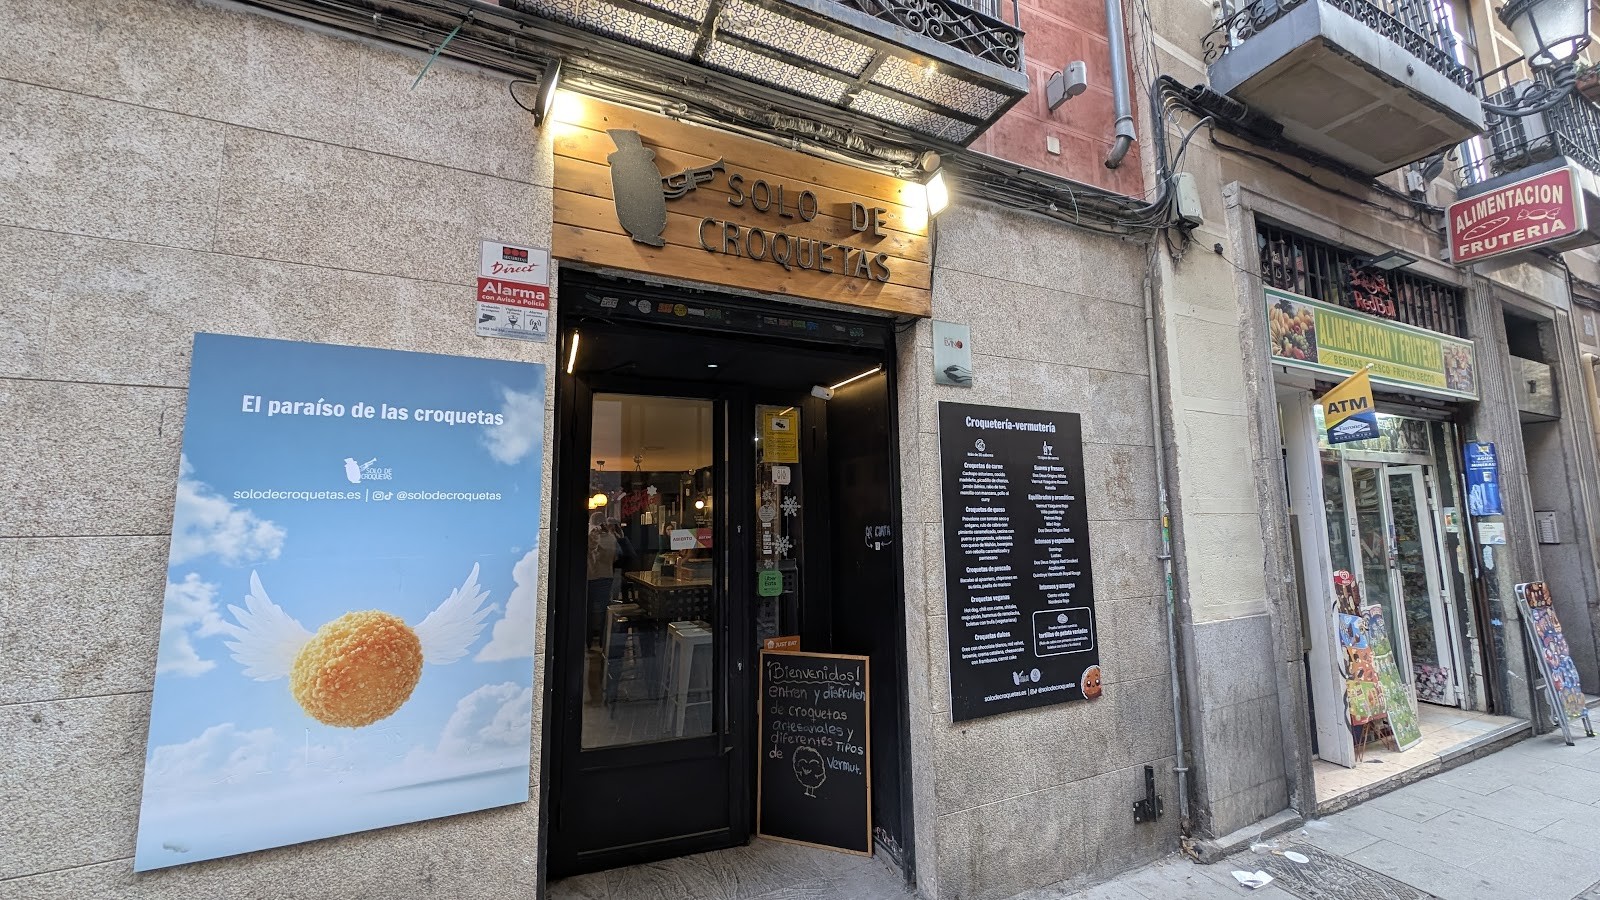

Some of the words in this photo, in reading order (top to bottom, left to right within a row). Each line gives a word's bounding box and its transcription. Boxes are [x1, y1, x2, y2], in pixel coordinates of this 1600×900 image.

[727, 173, 818, 222] SOLO
[851, 201, 888, 237] DE
[1456, 185, 1563, 235] ALIMENTACION
[698, 217, 891, 282] CROQUETAS
[1459, 219, 1566, 257] FRUTERIA
[491, 261, 540, 274] Direct
[482, 282, 545, 300] Alarma
[523, 298, 544, 306] Policía
[1354, 290, 1376, 311] Red
[1374, 297, 1396, 317] Bull
[1319, 314, 1393, 360] ALIMENTACION
[1391, 332, 1399, 361] Y
[1400, 334, 1442, 370] FRUTERIA
[1334, 355, 1362, 368] BEBIDAS
[1393, 367, 1416, 379] FRUTOS
[1417, 372, 1435, 383] SECOS
[242, 395, 261, 413] El
[268, 398, 345, 417] paraíso
[351, 402, 375, 418] de
[381, 404, 408, 420] las
[414, 408, 504, 425] croquetas
[1328, 396, 1368, 414] ATM
[965, 416, 1056, 433] Croquetería-vermutería
[233, 489, 361, 501] solodecroquetas.es
[397, 490, 502, 501] @solodecroquetas
[767, 661, 861, 686] ¡Bienvenidos!
[768, 686, 807, 700] entren
[814, 690, 821, 706] y
[770, 700, 784, 715] de
[788, 706, 847, 723] croquetas
[770, 731, 833, 747] diferentes
[772, 720, 843, 736] artesanales
[847, 728, 854, 742] y
[769, 744, 783, 759] de
[827, 756, 862, 775] Vermut.
